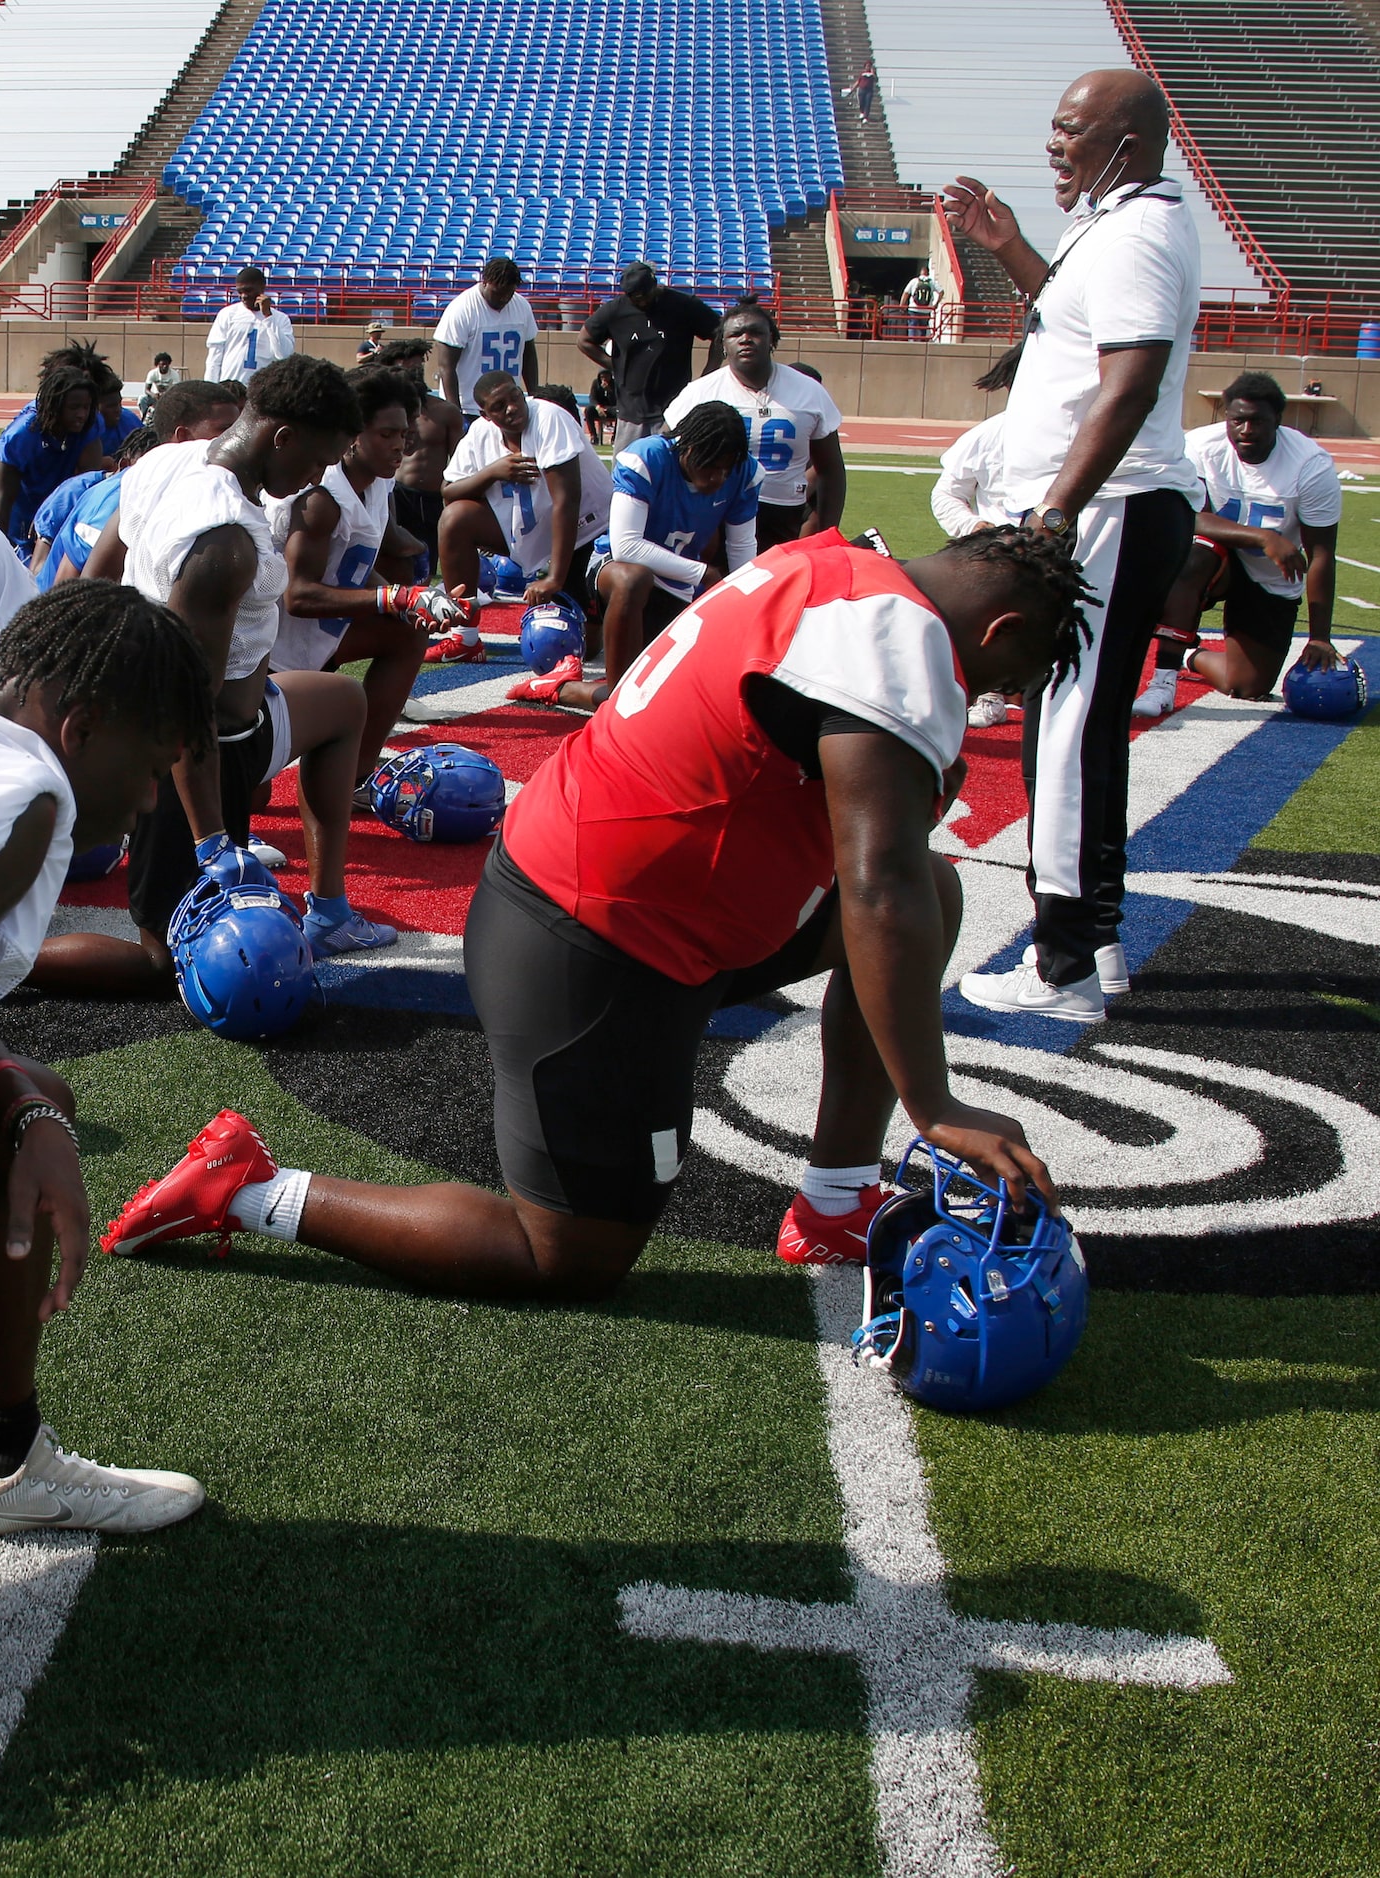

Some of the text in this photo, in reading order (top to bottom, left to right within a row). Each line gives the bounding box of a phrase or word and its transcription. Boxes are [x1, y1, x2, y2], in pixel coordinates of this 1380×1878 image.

[101, 217, 109, 227] C
[877, 232, 886, 241] D
[243, 328, 259, 370] 1
[481, 330, 521, 377] 52
[609, 561, 776, 720] 5
[206, 1153, 234, 1170] VAPOR
